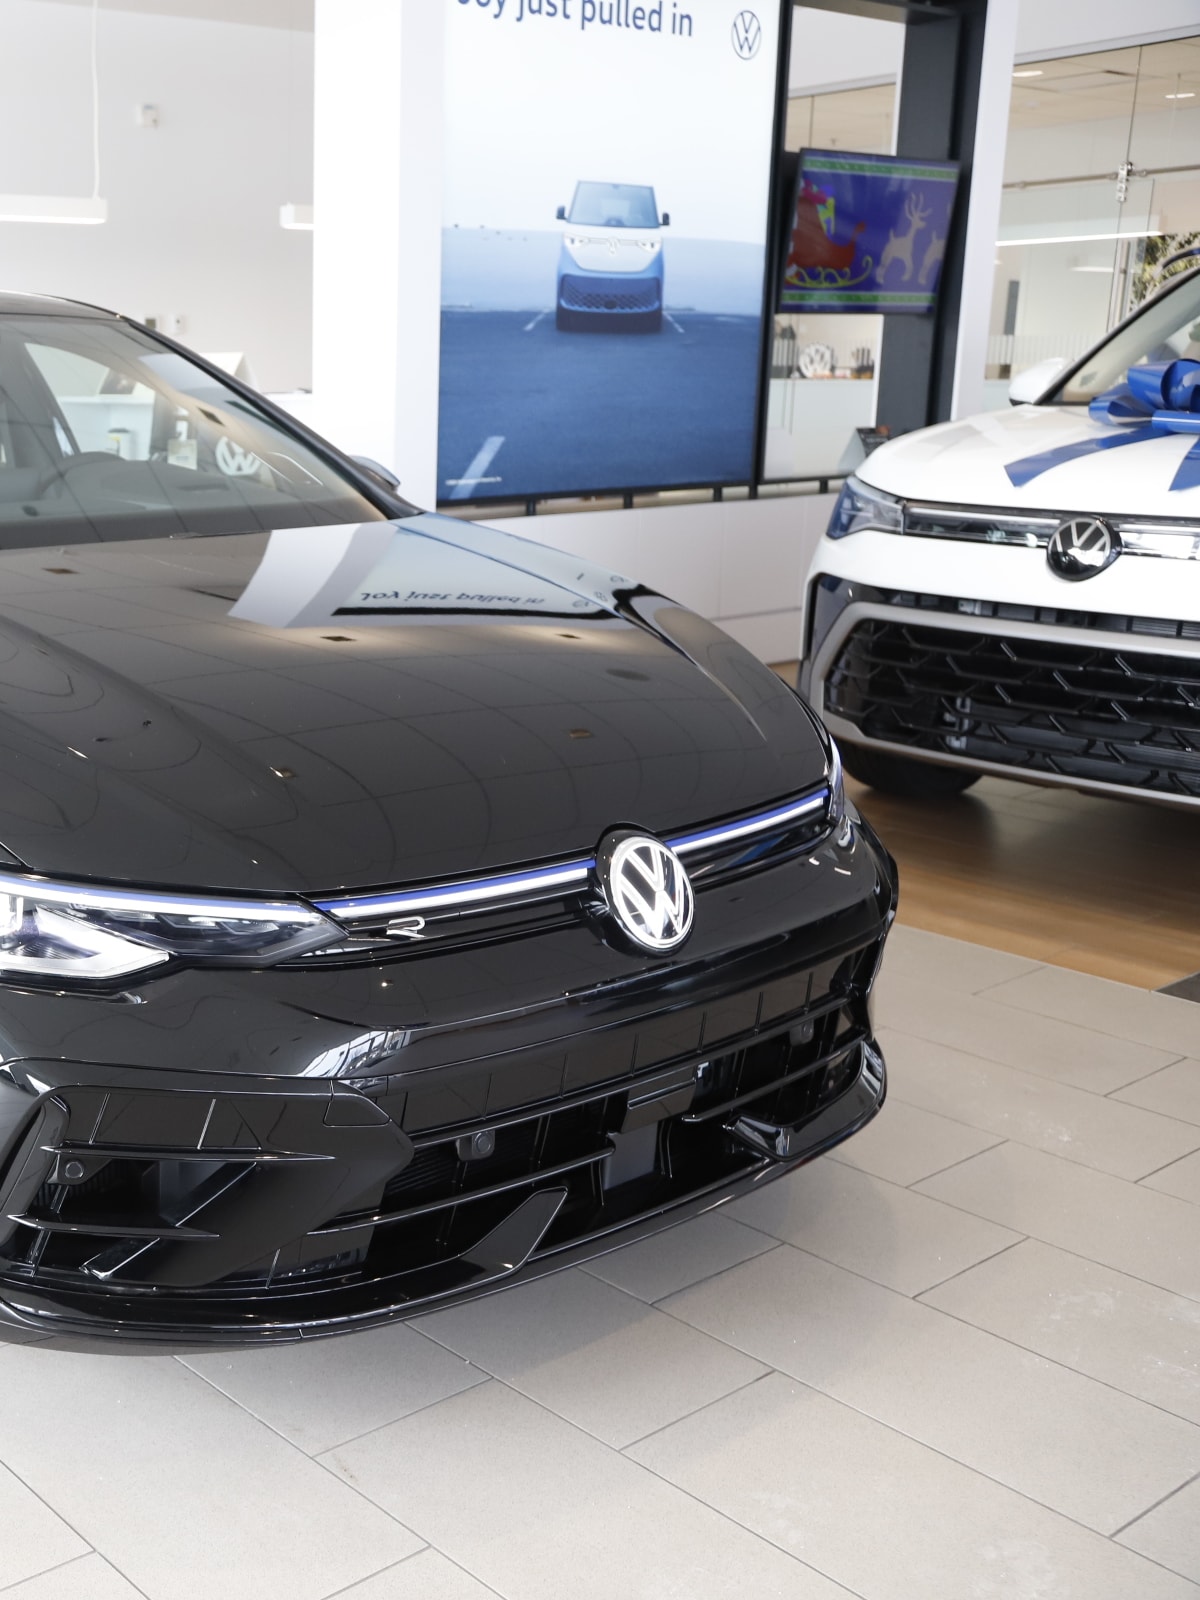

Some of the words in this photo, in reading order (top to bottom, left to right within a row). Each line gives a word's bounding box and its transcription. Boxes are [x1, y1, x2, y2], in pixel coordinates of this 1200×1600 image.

[580, 0, 662, 32] pulled
[671, 2, 693, 37] in
[608, 835, 695, 949] VW
